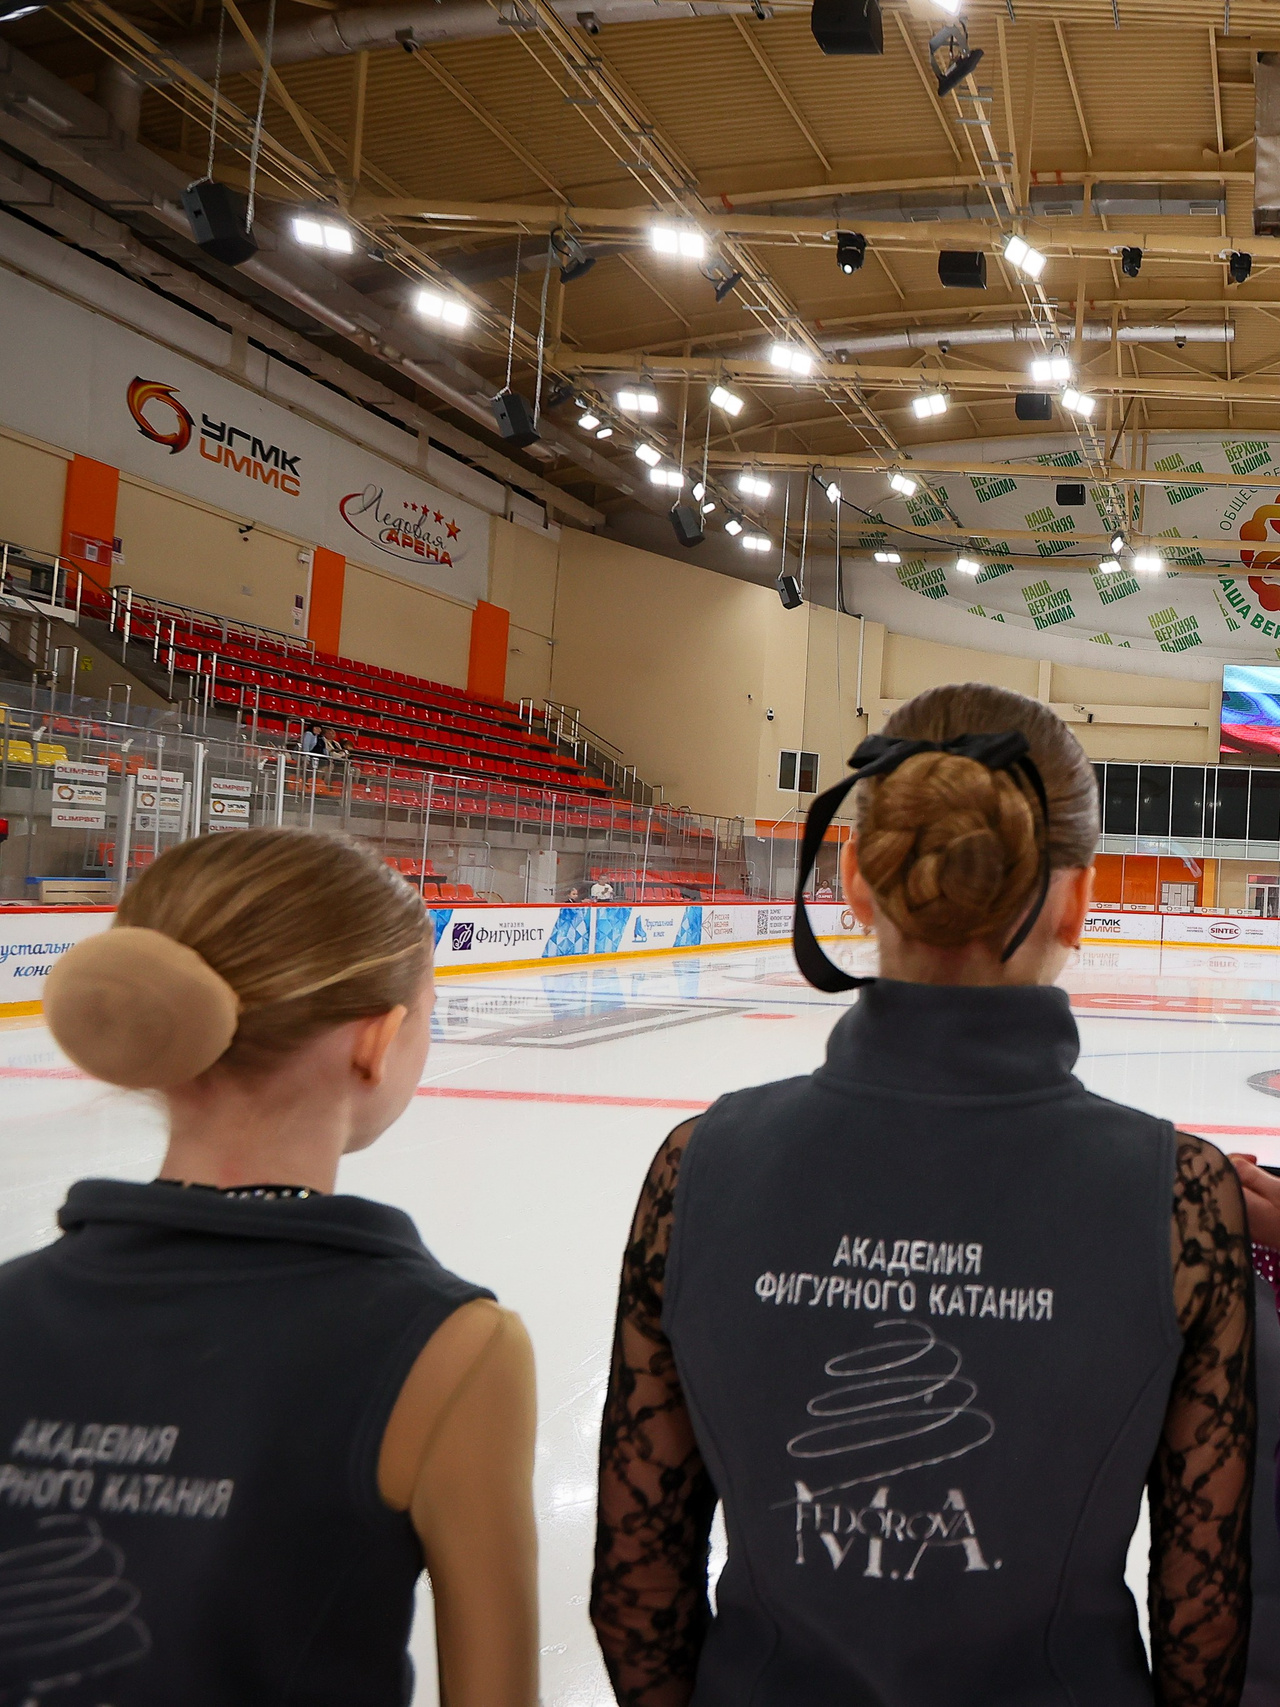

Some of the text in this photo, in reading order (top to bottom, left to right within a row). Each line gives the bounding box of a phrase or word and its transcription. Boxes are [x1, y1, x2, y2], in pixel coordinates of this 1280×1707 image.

[202, 413, 301, 477] УГМК
[200, 437, 300, 497] UMMC
[1154, 453, 1184, 471] НАША
[1231, 451, 1272, 475] ПЫШМА
[1024, 506, 1055, 528] НАША
[386, 529, 453, 568] АРЕНА
[1021, 580, 1052, 602] НАША
[1027, 588, 1073, 617] ВЕРХНЯЯ
[1099, 578, 1141, 606] ПЫШМА
[1033, 605, 1076, 631] ПЫШМА
[1148, 606, 1179, 629] НАША
[1154, 615, 1199, 643] ВЕРХНЯЯ
[56, 766, 106, 777] OLIMPBET
[213, 782, 250, 791] OLIMPBET
[57, 815, 101, 823] OLIMPBET
[1084, 918, 1121, 927] УГМК
[1084, 925, 1121, 933] UMMC
[1210, 927, 1239, 935] SINTEC
[475, 927, 545, 947] Фигурист
[833, 1235, 983, 1277] АКАДЕМИЯ
[754, 1270, 1054, 1321] ФИГУРНОГО КАТАНИЯ
[12, 1419, 180, 1467] АКАДЕМИЯ
[100, 1474, 235, 1520] КАТАНИЯ
